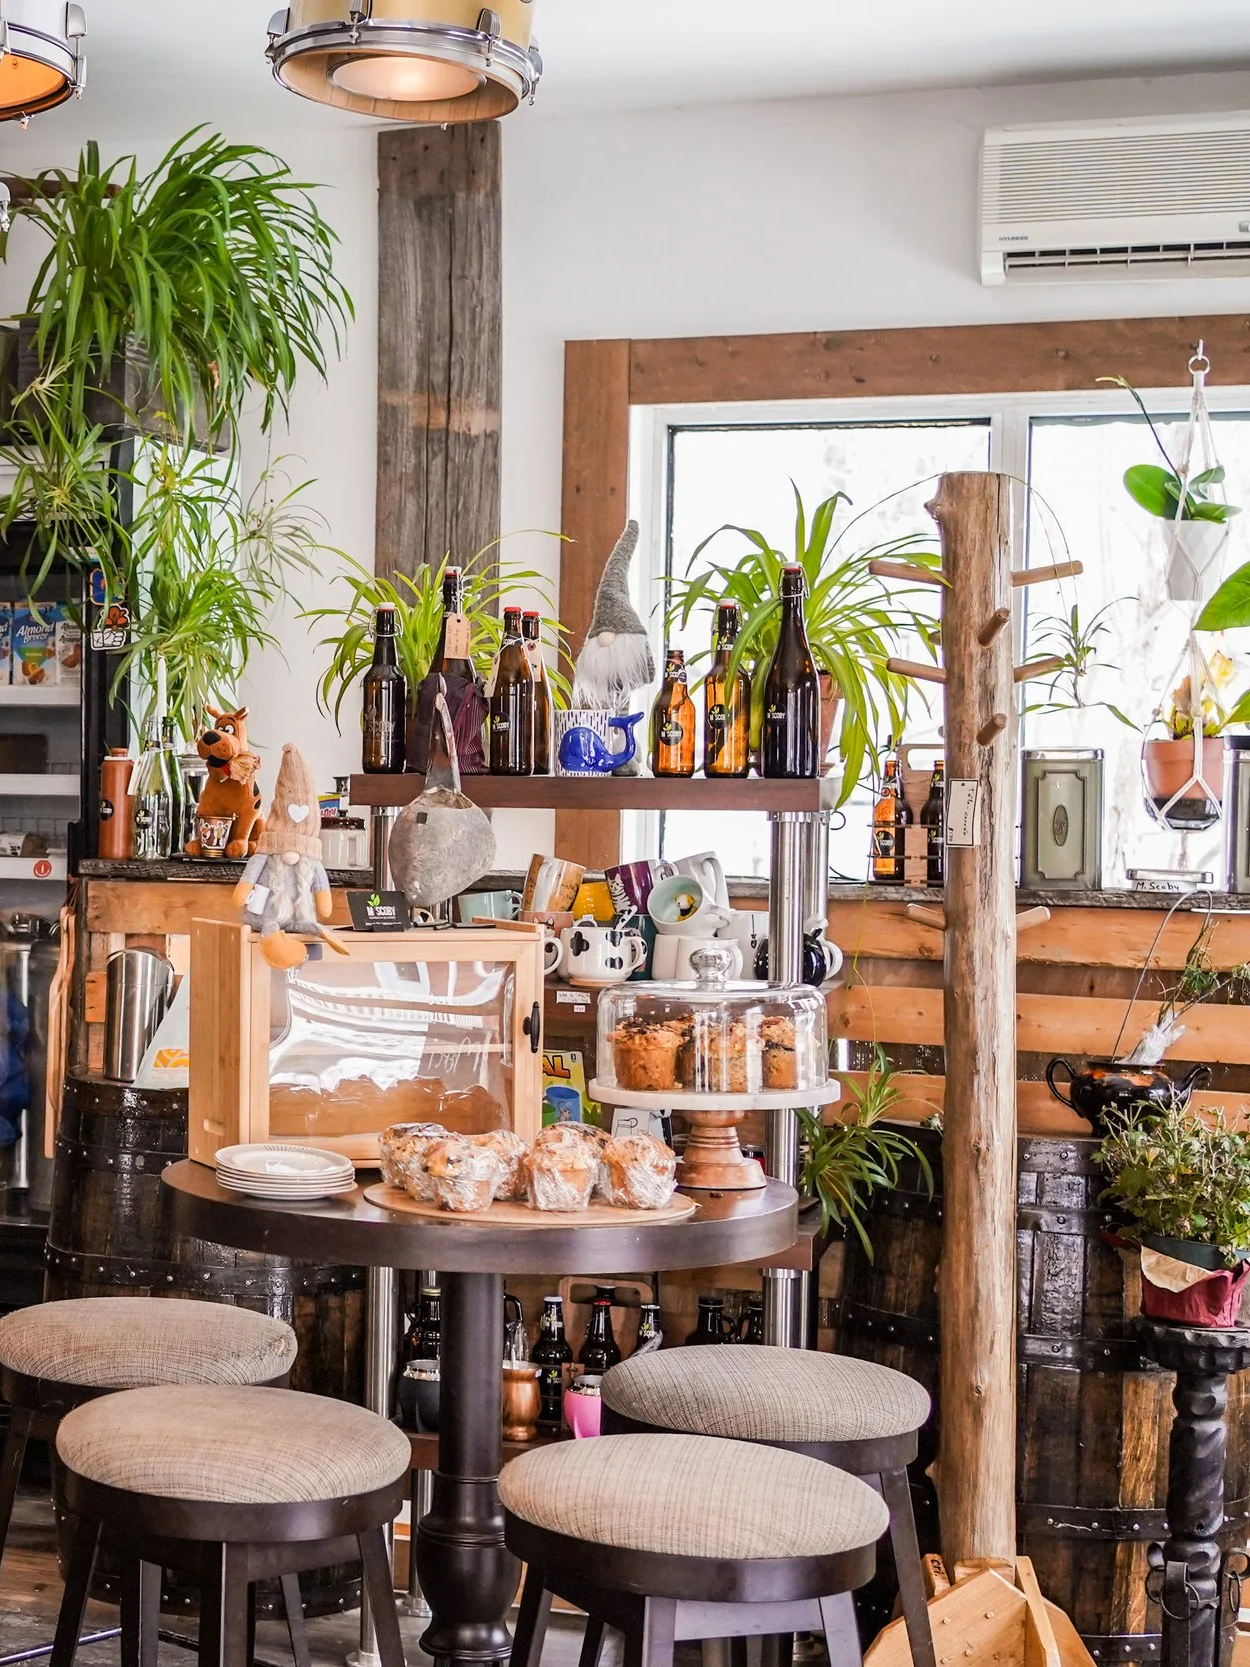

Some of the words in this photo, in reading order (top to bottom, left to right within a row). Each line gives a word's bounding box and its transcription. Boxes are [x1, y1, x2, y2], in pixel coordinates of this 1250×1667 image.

[15, 623, 54, 638] Almond
[1136, 881, 1147, 891] M.
[1149, 881, 1180, 891] Scoby
[375, 905, 396, 917] SCOBY
